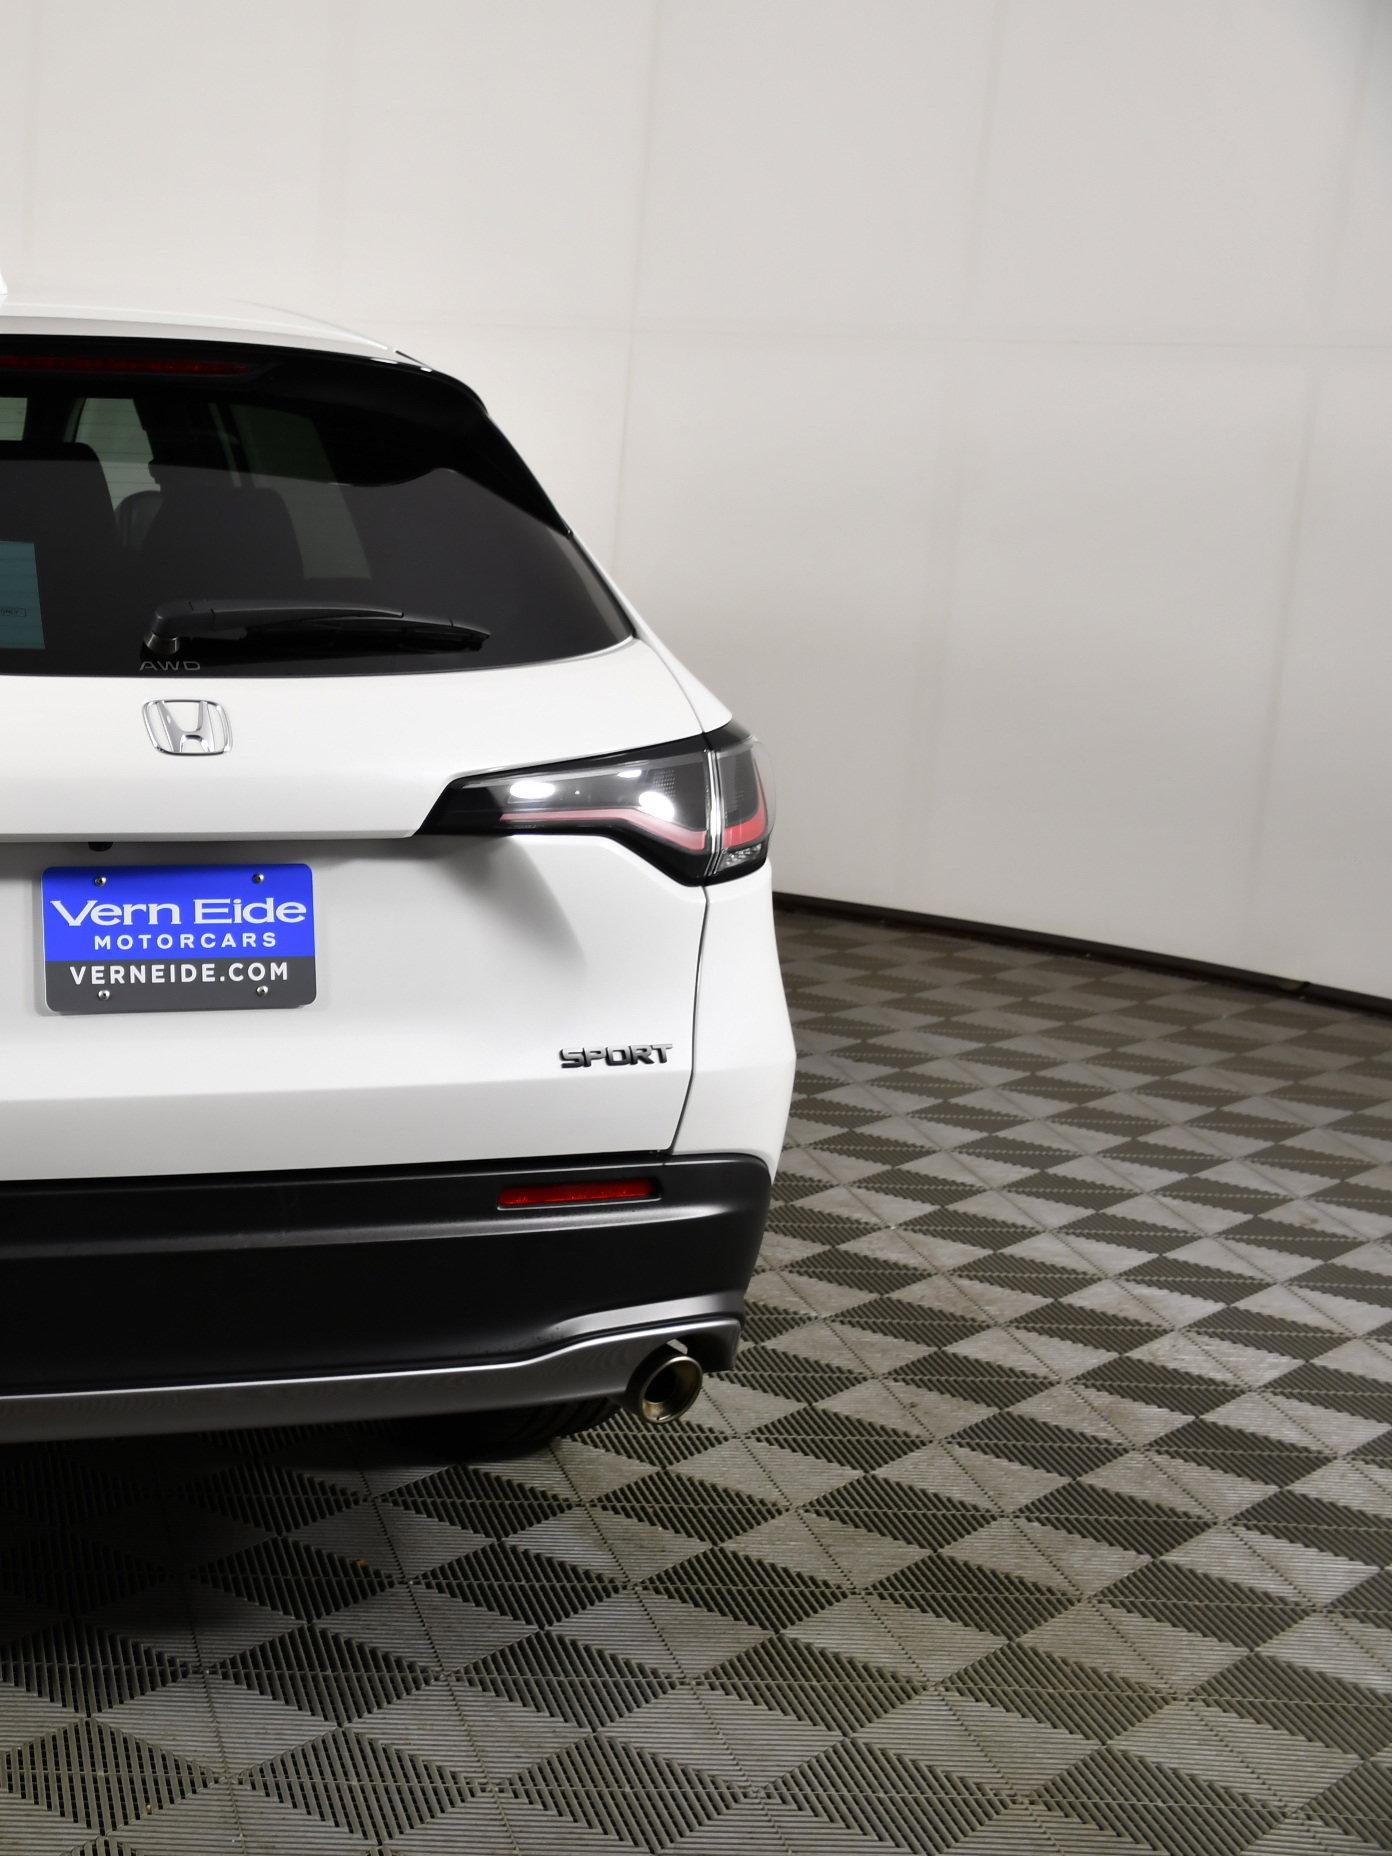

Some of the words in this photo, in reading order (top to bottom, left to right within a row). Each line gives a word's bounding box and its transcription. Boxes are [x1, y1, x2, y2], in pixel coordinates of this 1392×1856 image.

[139, 661, 201, 671] AWD
[49, 899, 182, 927] Vern
[193, 897, 307, 925] Eide
[94, 932, 277, 950] MOTORCARS
[69, 962, 288, 985] VERNEIDE.COM
[559, 1043, 673, 1068] SPORT
